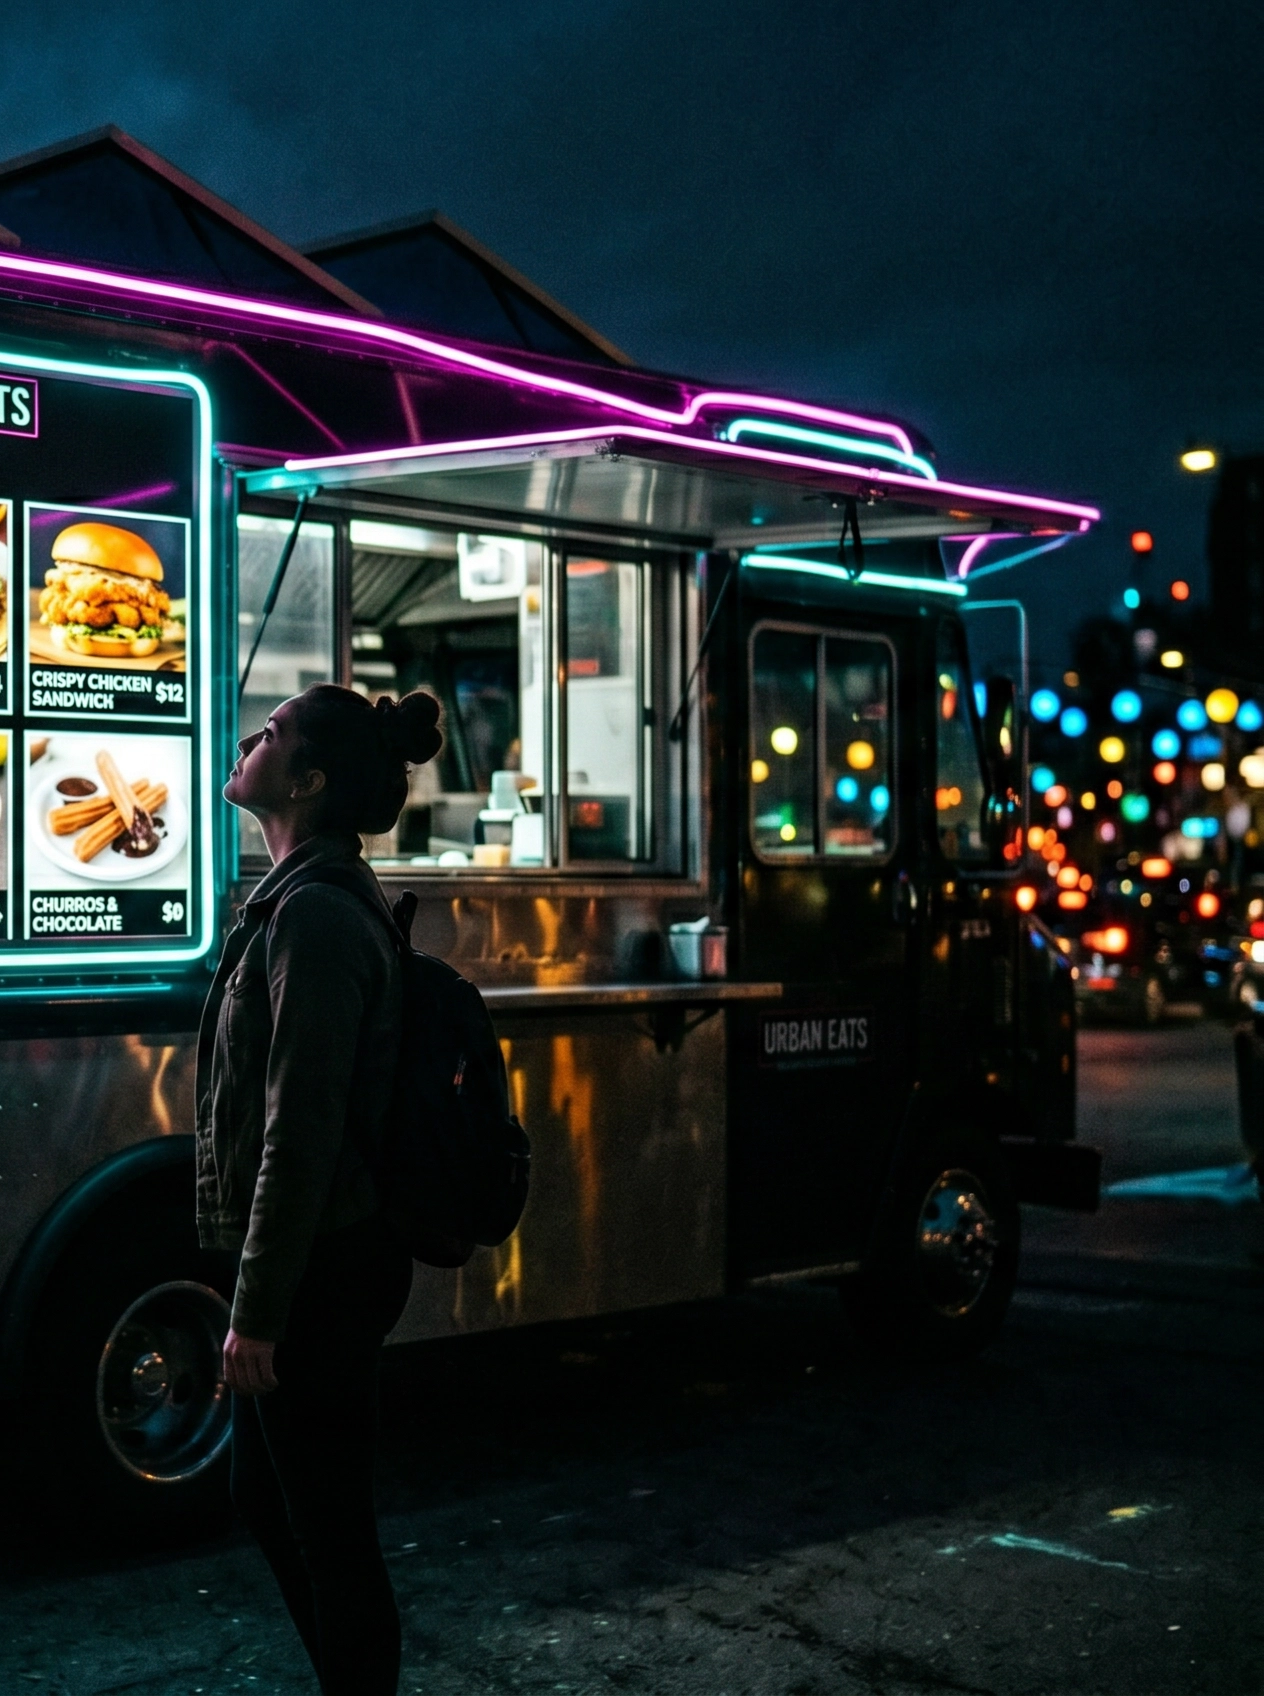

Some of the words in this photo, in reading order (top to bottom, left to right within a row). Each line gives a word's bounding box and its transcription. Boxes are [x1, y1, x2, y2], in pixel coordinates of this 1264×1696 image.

[32, 670, 85, 689] CRISPY
[87, 674, 152, 693] CHICKEN
[32, 691, 114, 710] SANDWICH
[155, 681, 184, 703] $12
[32, 897, 105, 913] CHURROS
[107, 897, 118, 912] &
[32, 915, 123, 932] CHOCOLATE
[764, 1020, 822, 1054] URBAN
[827, 1017, 868, 1050] EATS
